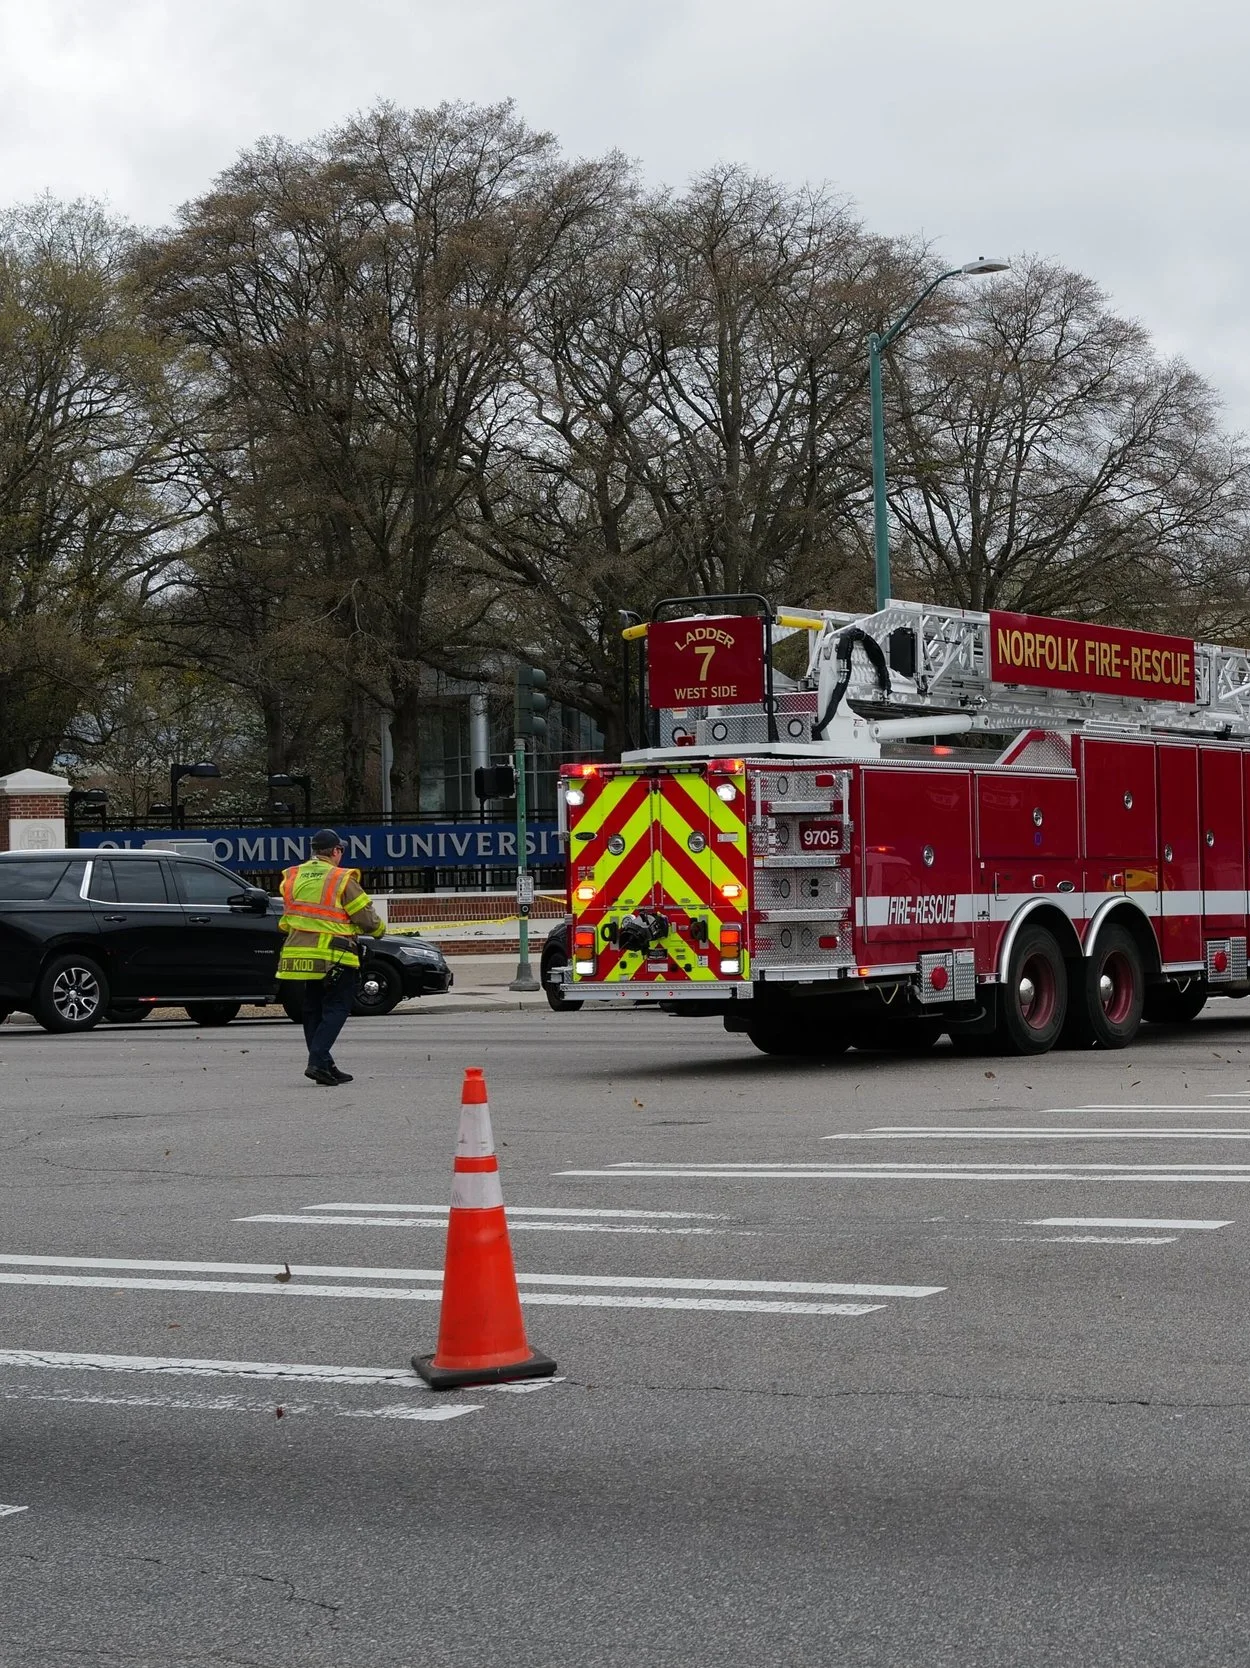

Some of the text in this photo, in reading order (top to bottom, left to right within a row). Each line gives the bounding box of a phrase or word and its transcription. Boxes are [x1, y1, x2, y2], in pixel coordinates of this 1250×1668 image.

[674, 627, 735, 651] LADDER
[694, 645, 716, 682] 7
[998, 628, 1191, 686] NORFOLK FIRE-RESCUE
[674, 685, 737, 700] WEST SIDE
[387, 831, 566, 859] UNIVERSIT
[804, 830, 839, 845] 9705
[888, 895, 955, 925] FIRE-RESCUE
[292, 959, 314, 971] KIDD
